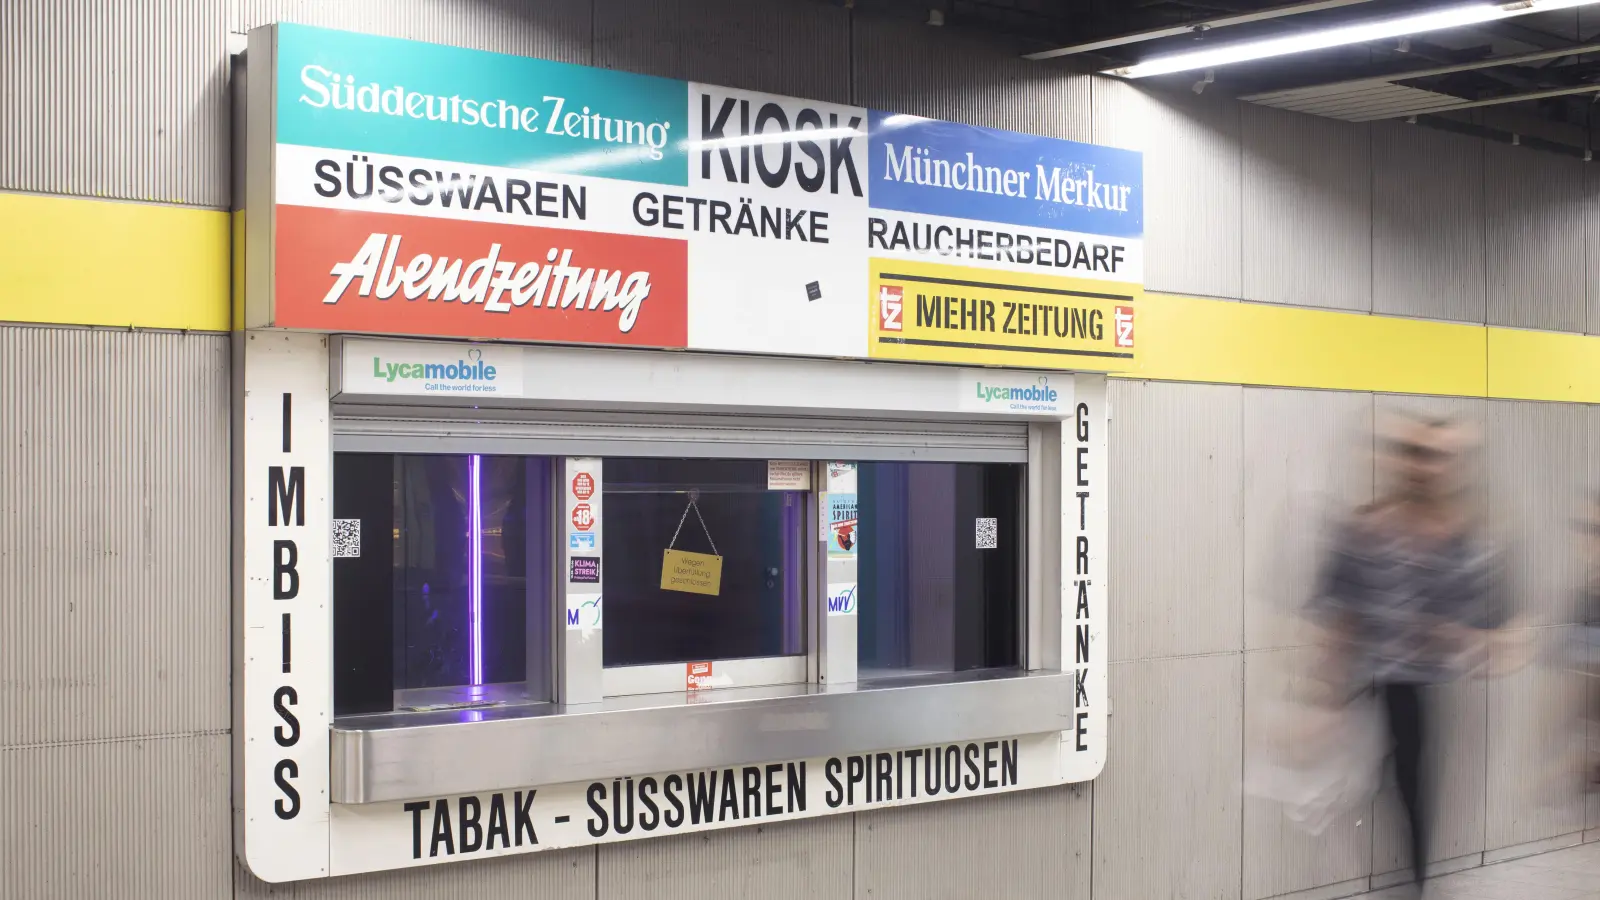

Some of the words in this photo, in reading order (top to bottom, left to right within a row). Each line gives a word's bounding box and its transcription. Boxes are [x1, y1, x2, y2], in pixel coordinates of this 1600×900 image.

[299, 65, 539, 134] Süddeutsche
[543, 95, 670, 161] Zeitung
[701, 94, 863, 198] KIOSK
[884, 142, 1030, 200] Münchner
[1035, 164, 1131, 213] Merkur
[314, 155, 587, 221] SÜSSWAREN
[632, 191, 830, 244] GETRÄNKE
[868, 217, 1125, 274] RAUCHERBEDARF
[322, 233, 652, 333] Abendzeitung
[880, 286, 903, 331] tz
[916, 294, 996, 331] MEHR
[1002, 302, 1104, 341] ZEITUNG
[1115, 308, 1134, 348] tz
[373, 355, 497, 383] Lycamobile
[424, 383, 439, 391] Call
[440, 383, 451, 391] the
[452, 384, 472, 392] world
[472, 384, 482, 392] for
[976, 381, 1058, 403] Lycamobile
[574, 559, 596, 567] KLIMA
[681, 557, 705, 567] Wegen
[1073, 402, 1092, 752] GETRÄNKE
[268, 393, 305, 820] IMBISS
[404, 789, 539, 860] TABAK
[554, 815, 570, 824] -
[586, 761, 807, 838] SÜSSWAREN
[825, 739, 1019, 808] SPIRITUOSEN
